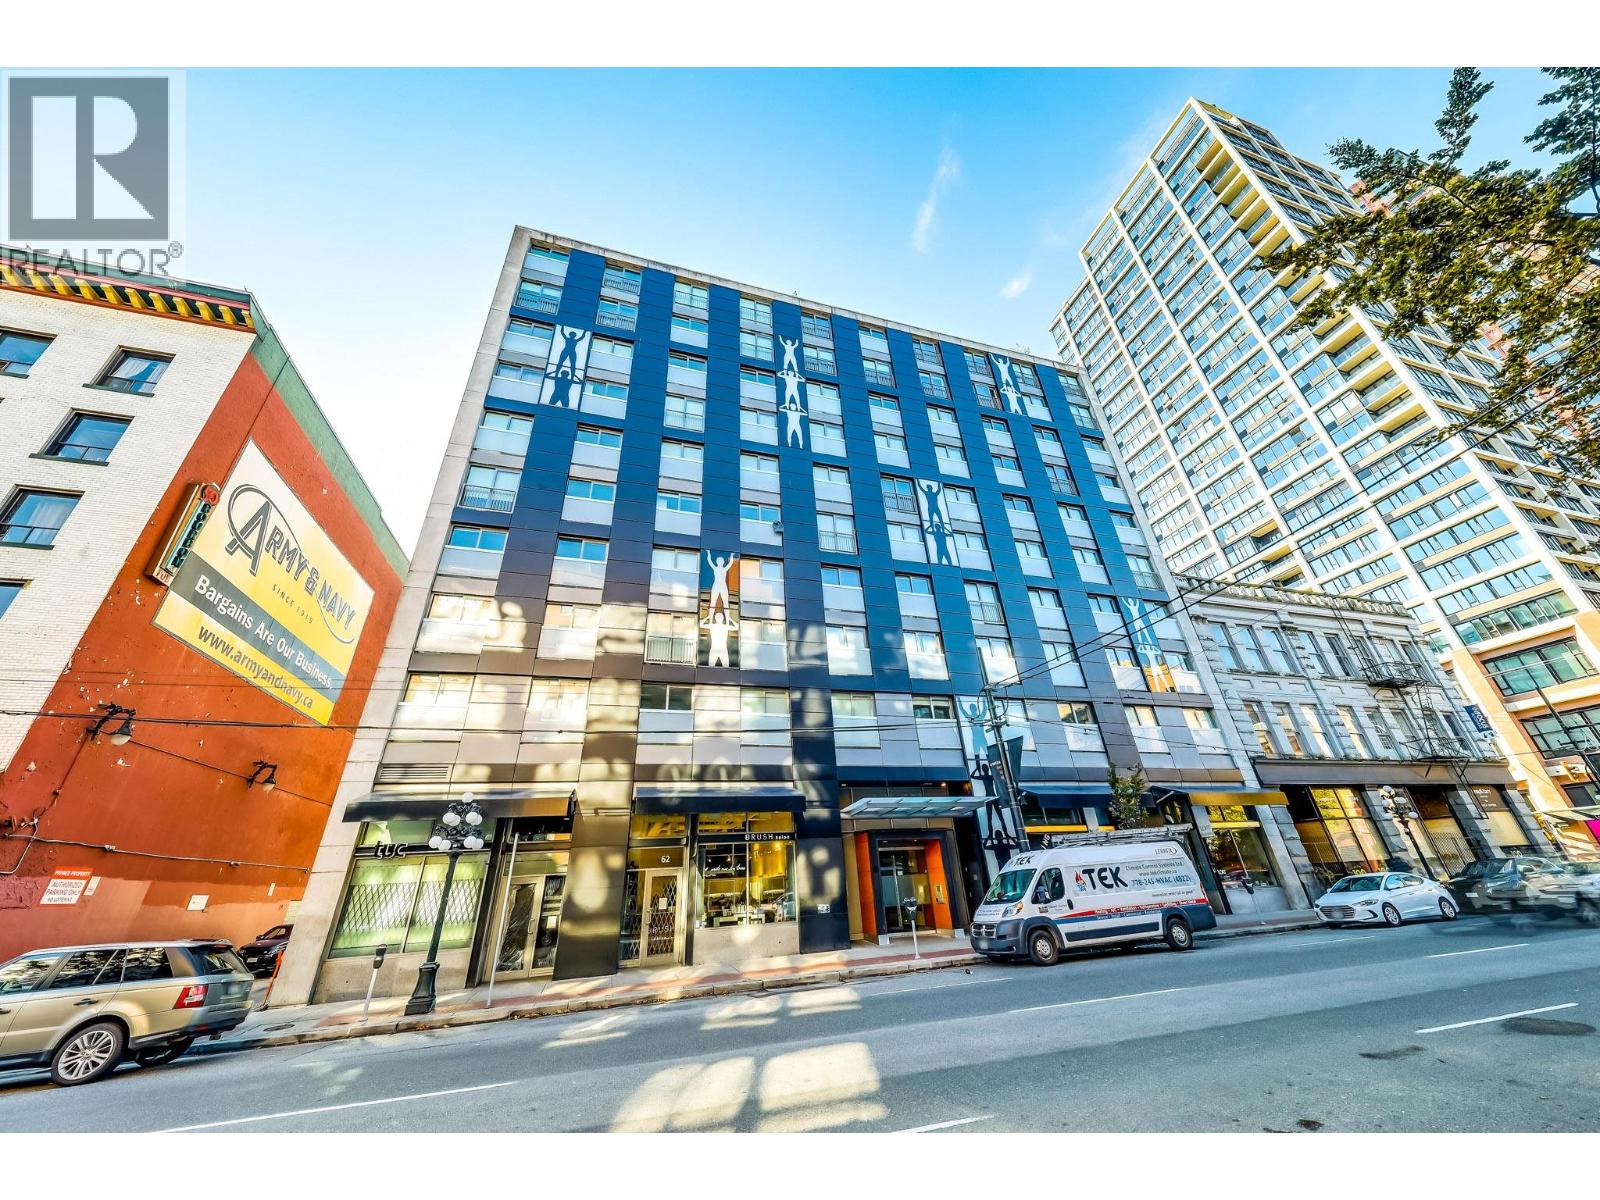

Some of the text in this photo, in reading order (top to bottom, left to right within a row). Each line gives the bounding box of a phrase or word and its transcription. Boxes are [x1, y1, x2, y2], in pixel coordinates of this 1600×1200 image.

[225, 500, 356, 630] ARMY & NAVY
[272, 585, 296, 609] SINCE
[194, 575, 254, 629] Bargains
[254, 624, 274, 646] Are
[276, 638, 295, 661] Our
[198, 626, 314, 709] www.armyandnavy.ca
[744, 833, 774, 841] BRUSH
[660, 855, 670, 863] 62
[1013, 855, 1035, 867] TEK
[1081, 866, 1128, 890] TEK
